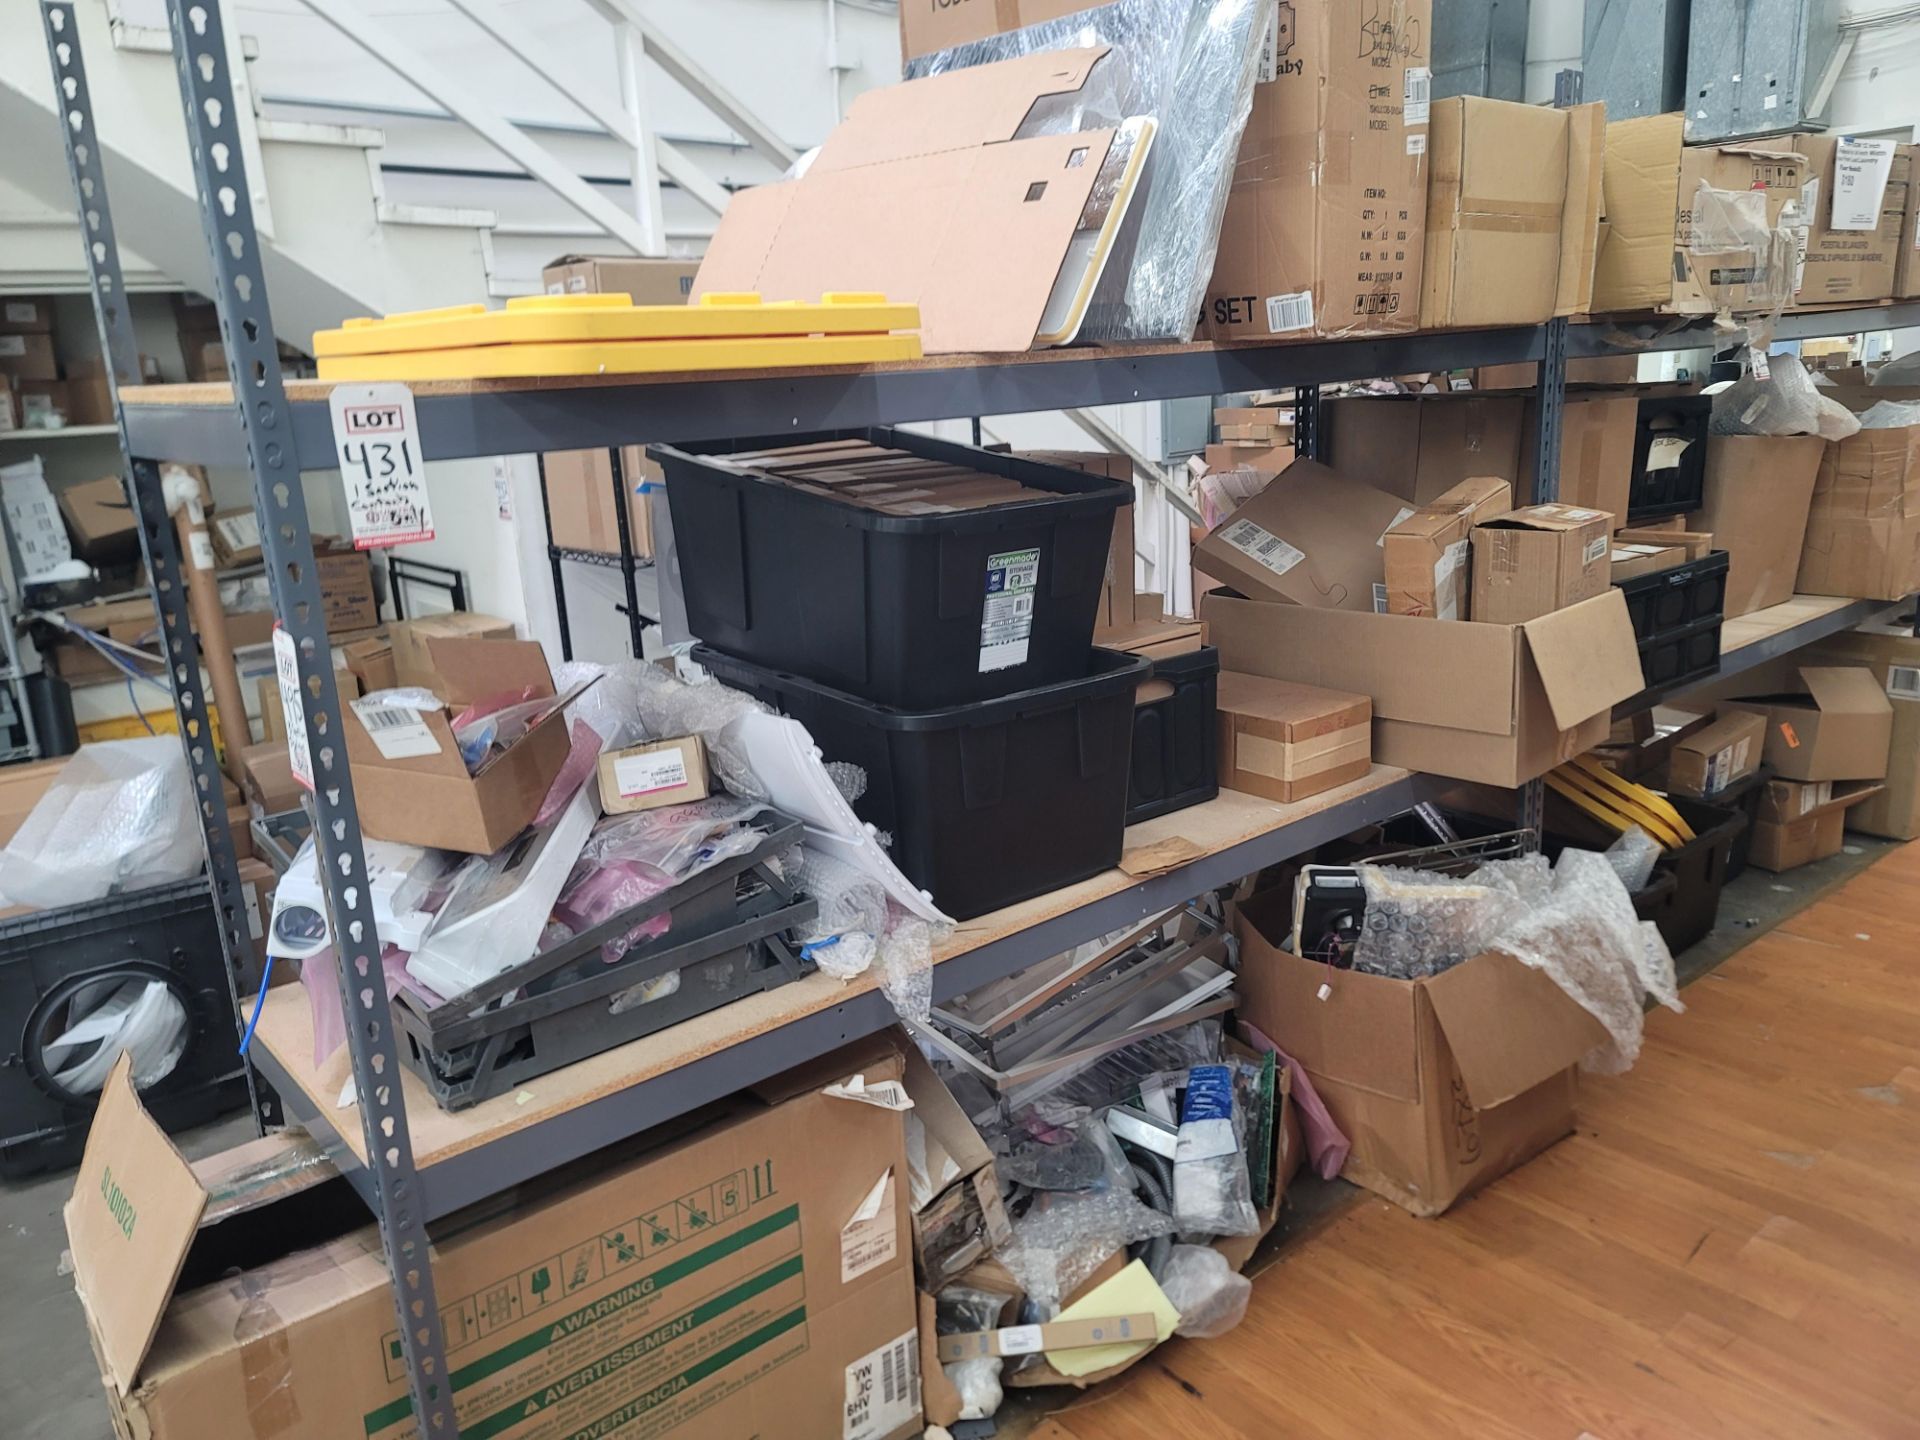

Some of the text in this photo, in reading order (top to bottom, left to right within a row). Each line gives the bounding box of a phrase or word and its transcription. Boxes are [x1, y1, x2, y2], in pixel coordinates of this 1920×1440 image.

[1276, 59, 1304, 76] aby
[1214, 296, 1257, 325] SET
[352, 411, 397, 428] LOT
[343, 437, 413, 480] 431
[989, 552, 1037, 568] Greenmade
[564, 1278, 655, 1332] WARNING
[544, 1313, 696, 1405] AVERTISSEMENT
[572, 1374, 690, 1440] DVERTENCIA
